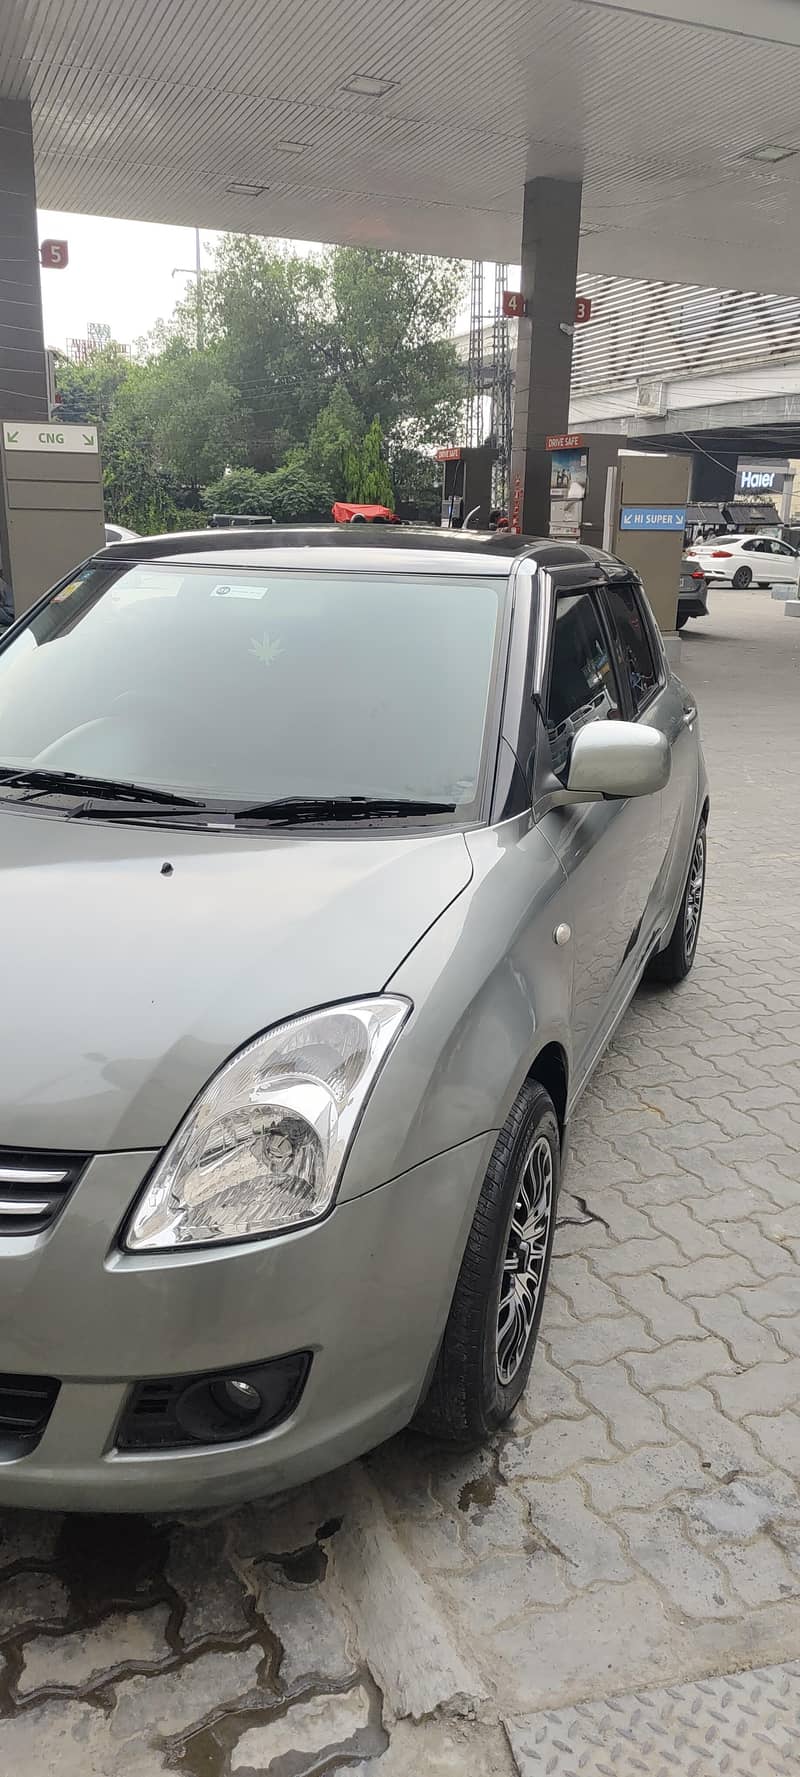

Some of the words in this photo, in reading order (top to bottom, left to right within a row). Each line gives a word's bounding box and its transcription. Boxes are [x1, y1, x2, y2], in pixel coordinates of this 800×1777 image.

[50, 245, 61, 263] 5
[508, 295, 518, 311] 4
[577, 303, 586, 318] 3
[38, 432, 65, 444] CNG
[548, 438, 564, 448] DRIVE
[565, 436, 579, 446] SAFE
[741, 471, 776, 488] Haier
[634, 514, 643, 523] HI
[646, 514, 673, 524] SUPER
